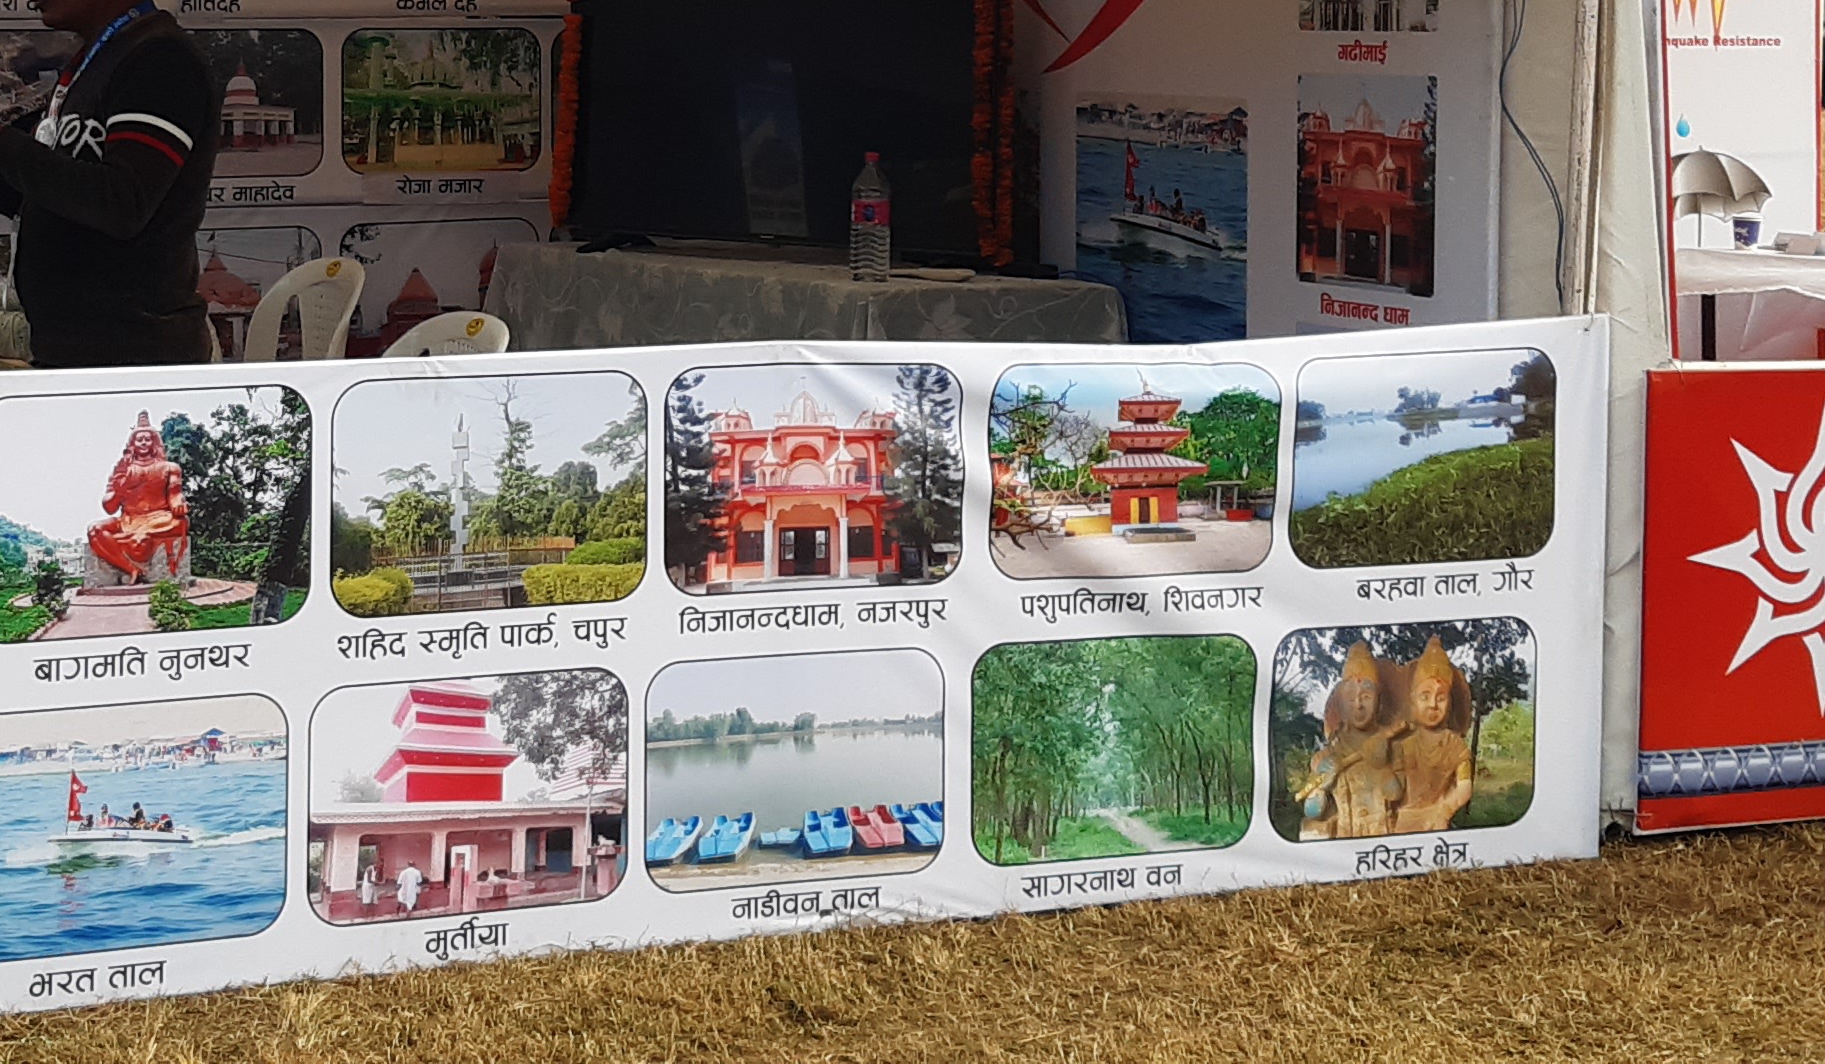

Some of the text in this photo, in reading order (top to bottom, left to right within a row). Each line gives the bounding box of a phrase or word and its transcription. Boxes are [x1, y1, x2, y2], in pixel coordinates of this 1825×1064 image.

[1664, 35, 1782, 49] hquake Resistance
[232, 180, 296, 202] माहादेव
[396, 175, 485, 195] रोजा मजार
[1320, 293, 1379, 323] निजानन्द
[1356, 561, 1535, 601] बरहवा ताल, गौर
[679, 599, 948, 635] निजानन्दधाम, नजरपुर
[1020, 585, 1265, 624] पशुपतिनाथ, शिवनगर
[337, 613, 628, 660] शहिद स्मृति पार्क, चपुर
[33, 644, 252, 682] बागमति नुनथर
[1355, 837, 1470, 875] हरिहर क्षेत्र
[831, 886, 883, 912] ताल
[1021, 864, 1184, 899] सागरनाथ वन
[424, 916, 509, 961] मुर्तीया
[28, 960, 168, 999] भरत ताल
